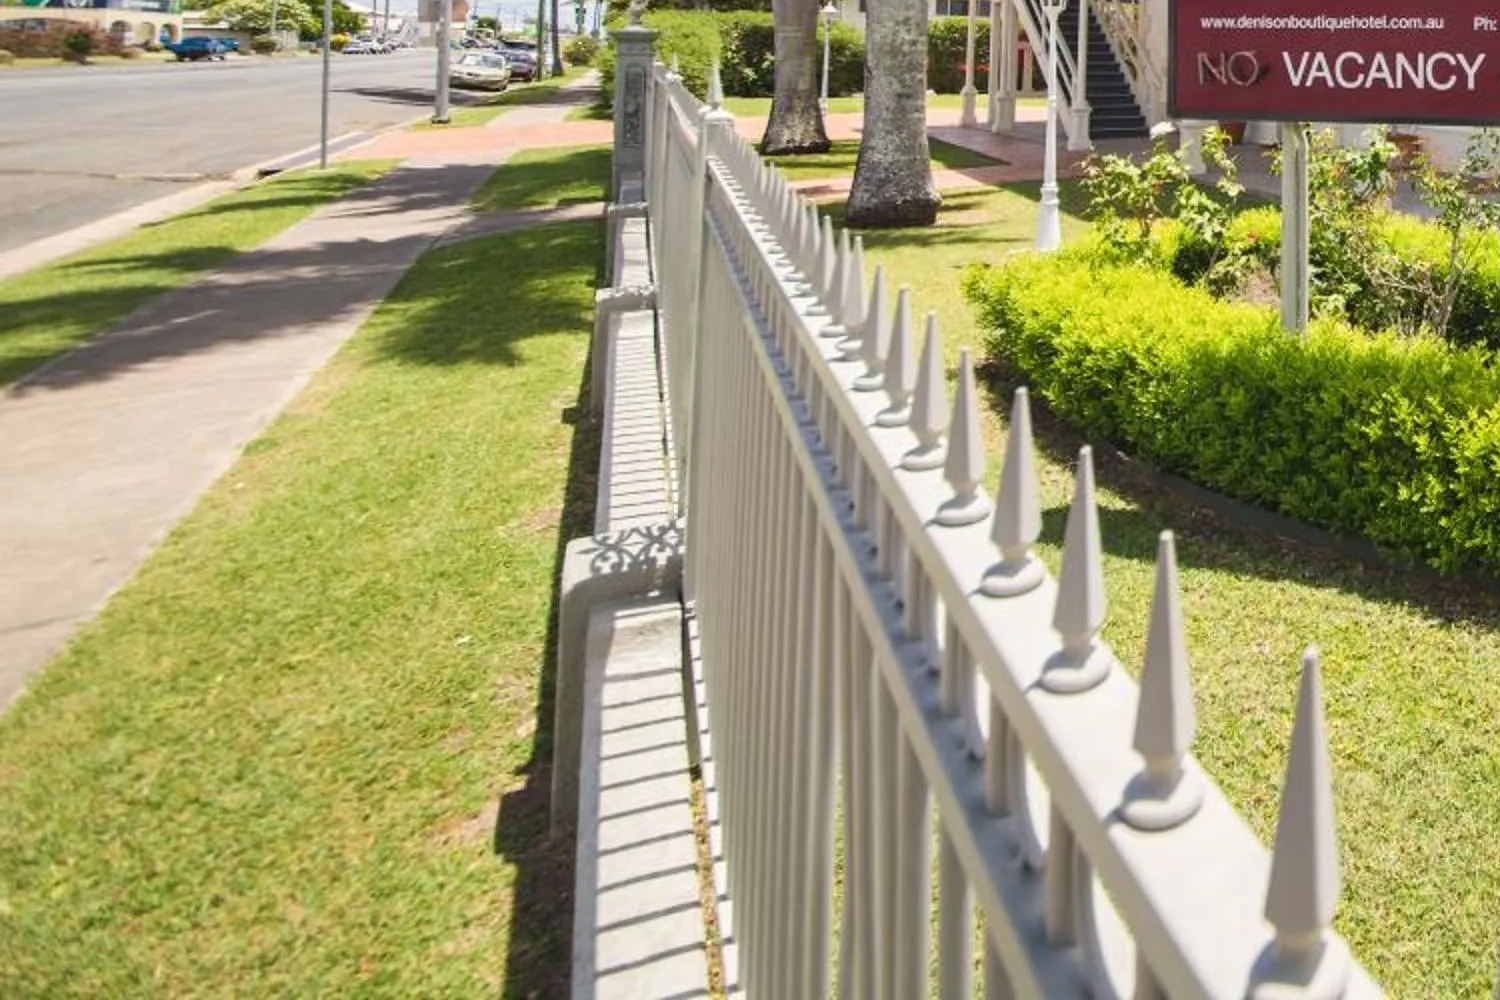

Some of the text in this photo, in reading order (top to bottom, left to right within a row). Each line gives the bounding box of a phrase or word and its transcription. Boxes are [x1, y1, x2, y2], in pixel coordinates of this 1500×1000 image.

[1200, 15, 1445, 32] www.denisonboutiquehotel.com.au
[1472, 16, 1498, 31] Ph:
[1197, 51, 1486, 90] NO VACANCY
